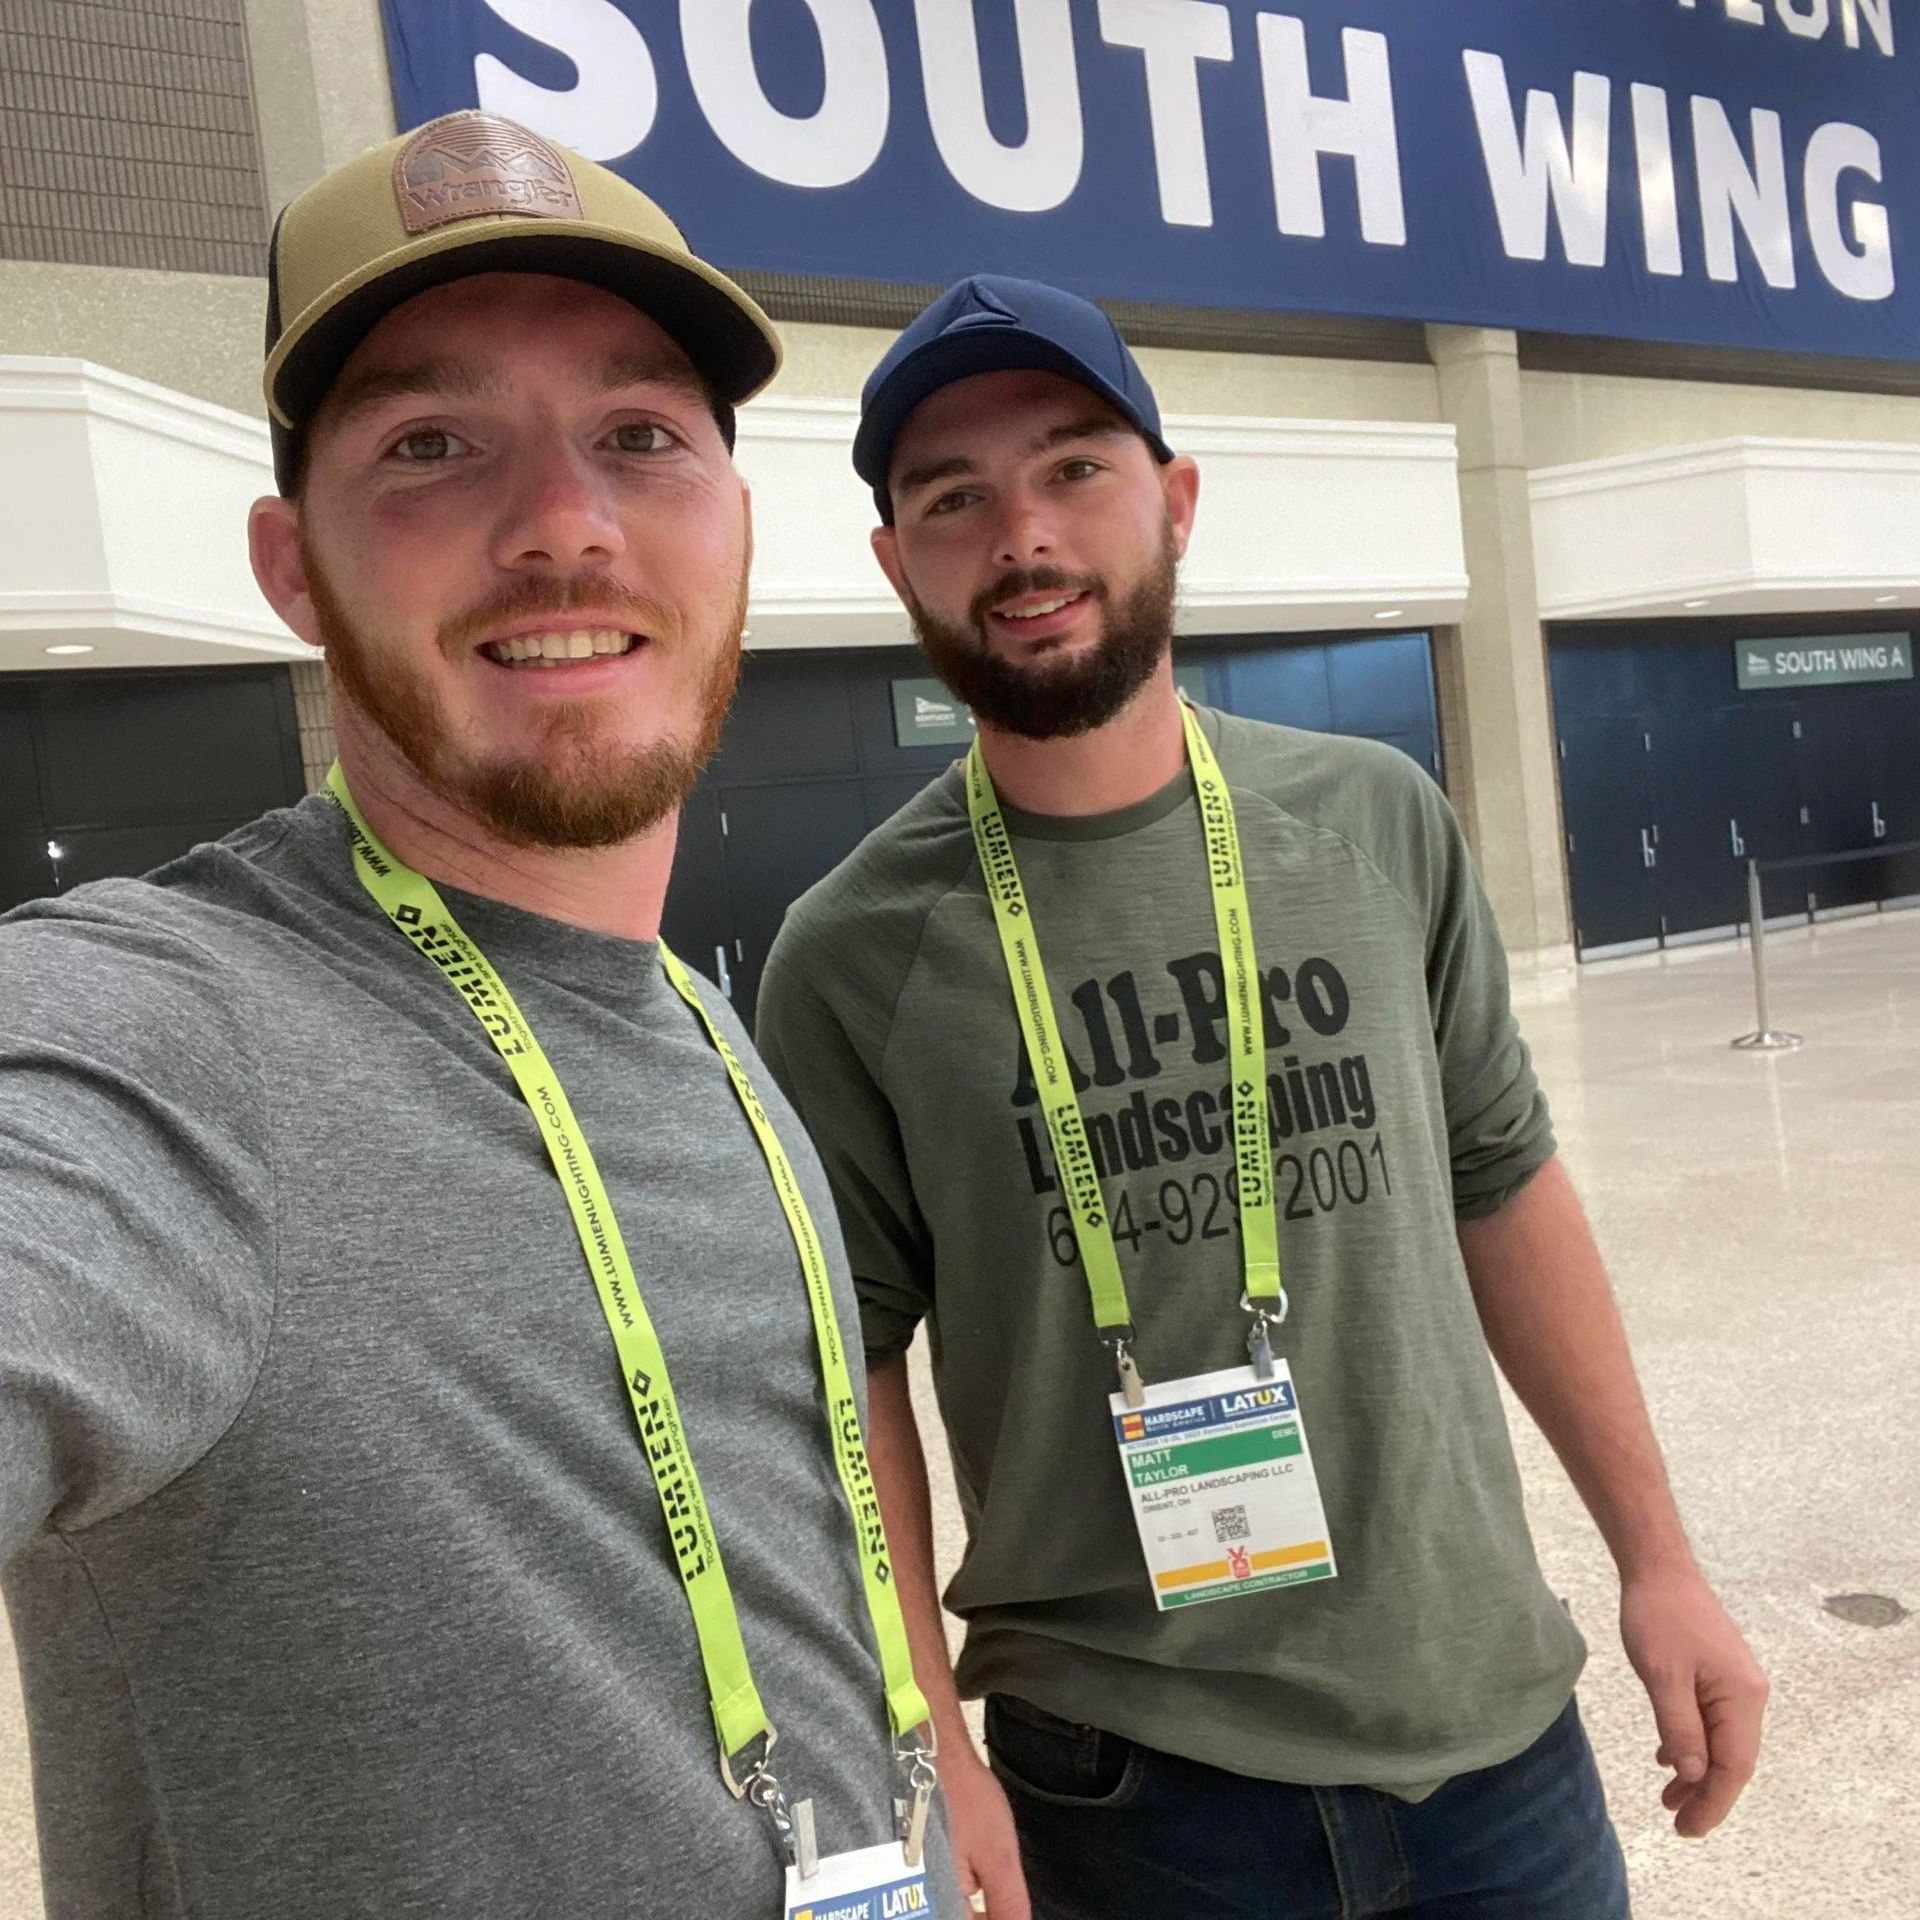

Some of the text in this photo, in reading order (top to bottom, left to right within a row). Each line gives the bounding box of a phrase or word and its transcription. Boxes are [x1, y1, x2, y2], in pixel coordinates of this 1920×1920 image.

[406, 178, 572, 211] Wrangler
[474, 0, 1894, 300] SOUTH WING
[1775, 649, 1837, 675] SOUTH
[1839, 647, 1888, 670] WING
[1891, 646, 1905, 668] A
[981, 811, 1021, 900] LUMIEN
[1203, 795, 1232, 888] LUMIEN
[410, 925, 525, 1056] LUMIEN
[1015, 939, 1058, 1085] WWW.LUMIENLIGHTING.COM
[1228, 908, 1253, 1056] WWW.LUMIENLIGHTING.COM
[1016, 1055, 1376, 1194] Lndscping
[1057, 1104, 1100, 1209] LUMIEN
[1237, 1101, 1262, 1208] LUMIEN
[537, 1086, 634, 1329] WWW.LUMIENLIGHTING.COM
[777, 1155, 838, 1367] WWW.LUMIENLIGHTING.COM
[1144, 1406, 1205, 1425] HARDSCAPE
[1221, 1386, 1287, 1413] LATUX
[639, 1401, 706, 1582] LUMIEN
[839, 1398, 886, 1555] LUMIEN
[1131, 1449, 1172, 1468] MATT
[1135, 1464, 1189, 1484] TAYLOR
[1141, 1464, 1294, 1503] ALL-PRO LANDSCAPING LLC
[1184, 1583, 1241, 1600] LANDSCAPE
[882, 1881, 928, 1919] LATUX
